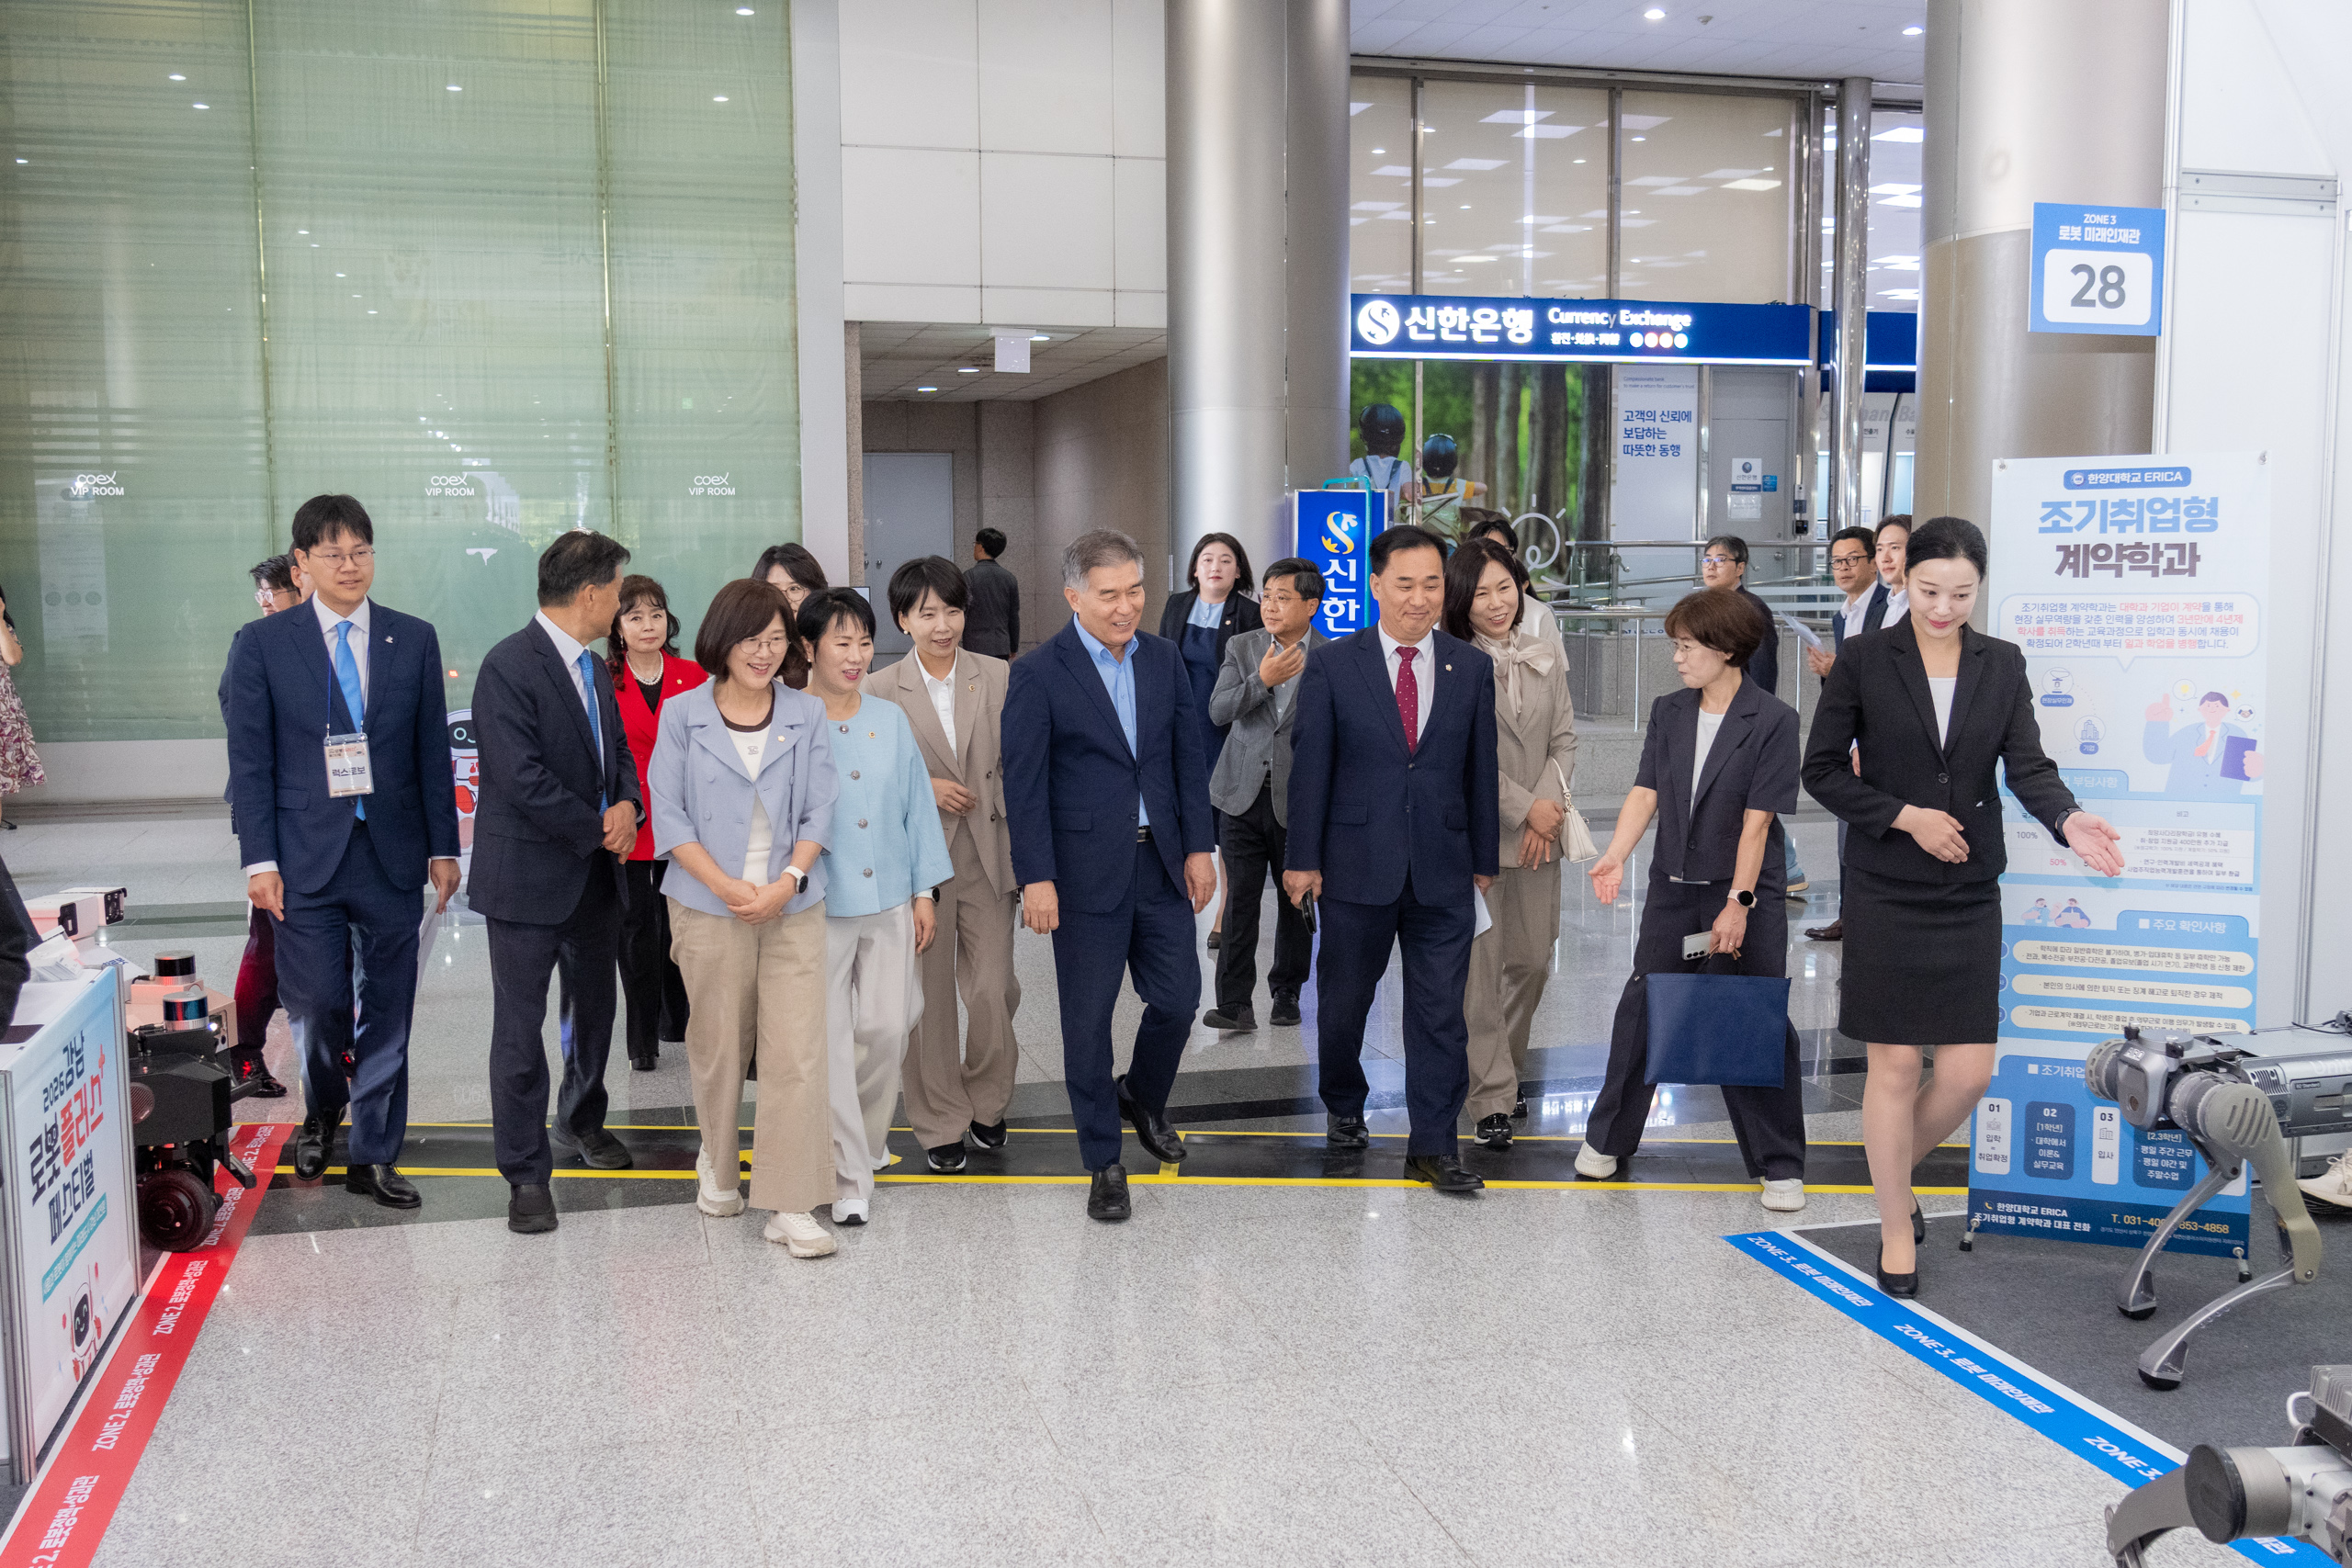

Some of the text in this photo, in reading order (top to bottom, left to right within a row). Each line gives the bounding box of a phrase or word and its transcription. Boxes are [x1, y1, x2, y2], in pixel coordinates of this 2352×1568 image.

[2083, 213, 2117, 225] ZONE 3
[2059, 225, 2141, 244] 로봇 미래인재관
[2070, 264, 2126, 310] 28
[1404, 306, 1533, 344] 신한은행
[1548, 307, 1692, 332] Currency Exchange
[1623, 410, 1692, 423] 고객의 신뢰에
[1623, 427, 1668, 440] 보답하는
[1623, 444, 1681, 457] 따뜻한 동행
[77, 470, 117, 485] coex
[431, 472, 467, 486] coex
[694, 472, 729, 486] coex
[2087, 471, 2183, 484] 한양대학교 ERICA
[71, 487, 124, 496] VIP ROOM
[425, 488, 475, 496] VIP ROOM
[689, 488, 736, 496] VIP ROOM
[2038, 496, 2219, 535] 조기취업형
[2054, 542, 2201, 579] 계약학과
[1321, 558, 1361, 640] 신한
[2021, 602, 2233, 613] 조기취업형 계약학과는 대학과 기업이 계약을 통해
[2014, 615, 2244, 625] 현장 실무역량을 갖춘 인력을 양성하여 3년만에 4년제
[2017, 626, 2239, 637] 학사를 취득하는 교육과정으로 입학과 동시에 채용이
[2026, 638, 2229, 649] 확정되어 2학년때 부터 일과 학업을 병행합니다.
[332, 765, 367, 777] 럭스로보
[2073, 776, 2118, 788] 부담사항
[2017, 831, 2039, 840] 100%
[2050, 858, 2067, 866] 50%
[2153, 919, 2226, 934] 주요 확인사항
[2086, 984, 2100, 992] 의한
[2102, 985, 2116, 993] 퇴직
[2117, 986, 2131, 994] 또는
[2132, 987, 2146, 995] 징계
[2148, 988, 2169, 997] 해고로
[2170, 989, 2191, 998] 퇴직한
[2048, 1010, 2072, 1019] 근로계약
[2136, 1016, 2161, 1024] 의무근로
[2176, 1019, 2195, 1027] 의무가
[2196, 1020, 2215, 1028] 발생할
[42, 1029, 85, 1113] 2026 강남
[1988, 1104, 2000, 1112] 01
[2042, 1108, 2057, 1117] 02
[2099, 1112, 2114, 1122] 03
[2036, 1122, 2064, 1134] [1학년]
[1985, 1134, 2001, 1143] 입학
[2035, 1136, 2066, 1147] 대학에서
[1977, 1152, 2008, 1163] 취업확정
[2038, 1148, 2060, 1158] 이론&
[2098, 1150, 2114, 1160] 입사
[2141, 1145, 2193, 1157] 평일 주간 근무
[2033, 1159, 2064, 1170] 실무교육
[2143, 1157, 2188, 1169] 평일 야간 및
[2147, 1169, 2179, 1181] 주말수업
[48, 1148, 96, 1247] 페스티벌
[1996, 1202, 2068, 1217] 한양대학교 ERICA
[2018, 1216, 2052, 1228] 계약학과
[2053, 1220, 2071, 1230] 대표
[2073, 1222, 2091, 1232] 전화
[2111, 1213, 2120, 1224] T.
[1747, 1235, 1875, 1307] ZONE 3. 로봇 미래인재관
[166, 1303, 187, 1314] 2.
[153, 1310, 182, 1336] ZONE
[1893, 1324, 2056, 1415] ZONE 3. 로봇 미래인재관
[107, 1408, 132, 1425] 2.
[92, 1419, 127, 1451] ZONE
[2083, 1436, 2149, 1470] ZONE
[31, 1549, 61, 1564] 2.
